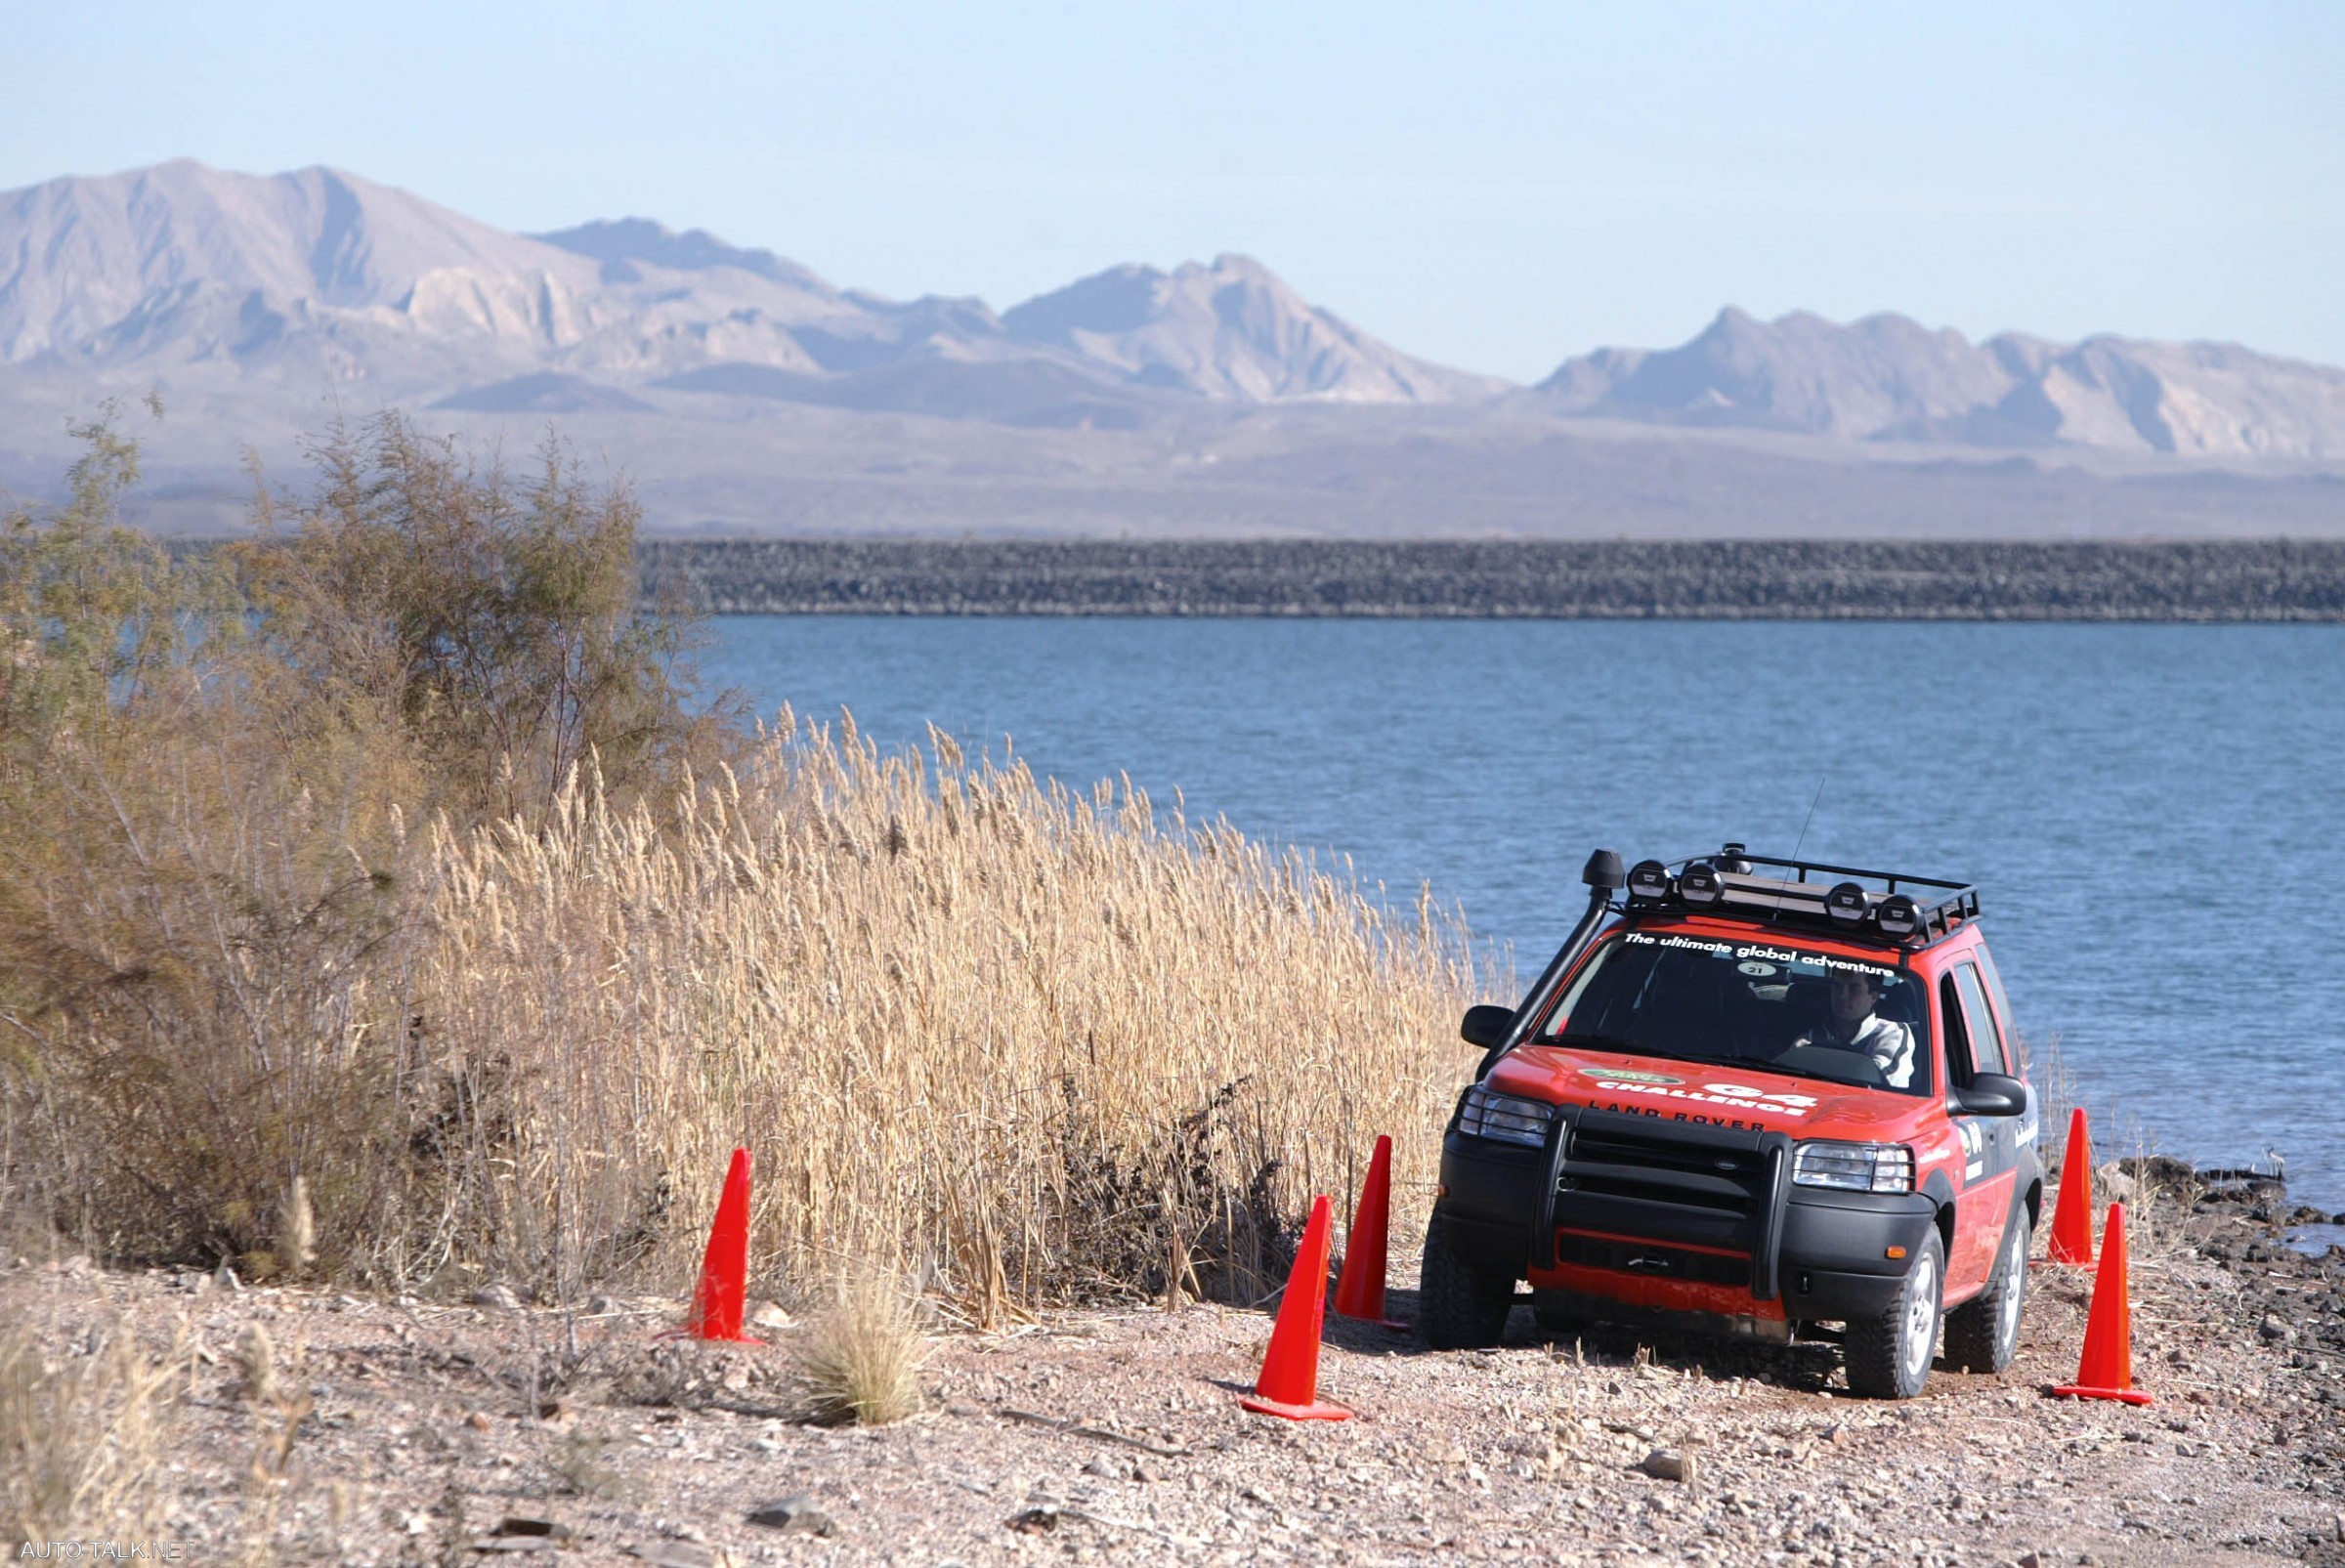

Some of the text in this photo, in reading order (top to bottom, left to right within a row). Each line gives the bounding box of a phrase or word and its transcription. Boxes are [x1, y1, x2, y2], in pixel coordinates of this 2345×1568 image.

[1624, 932, 1896, 978] The ultimate global adventure
[1747, 966, 1763, 975] 21
[1597, 1081, 1809, 1117] CHALLENGE
[1702, 1082, 1818, 1108] G4
[1589, 1099, 1767, 1132] LAND ROVER
